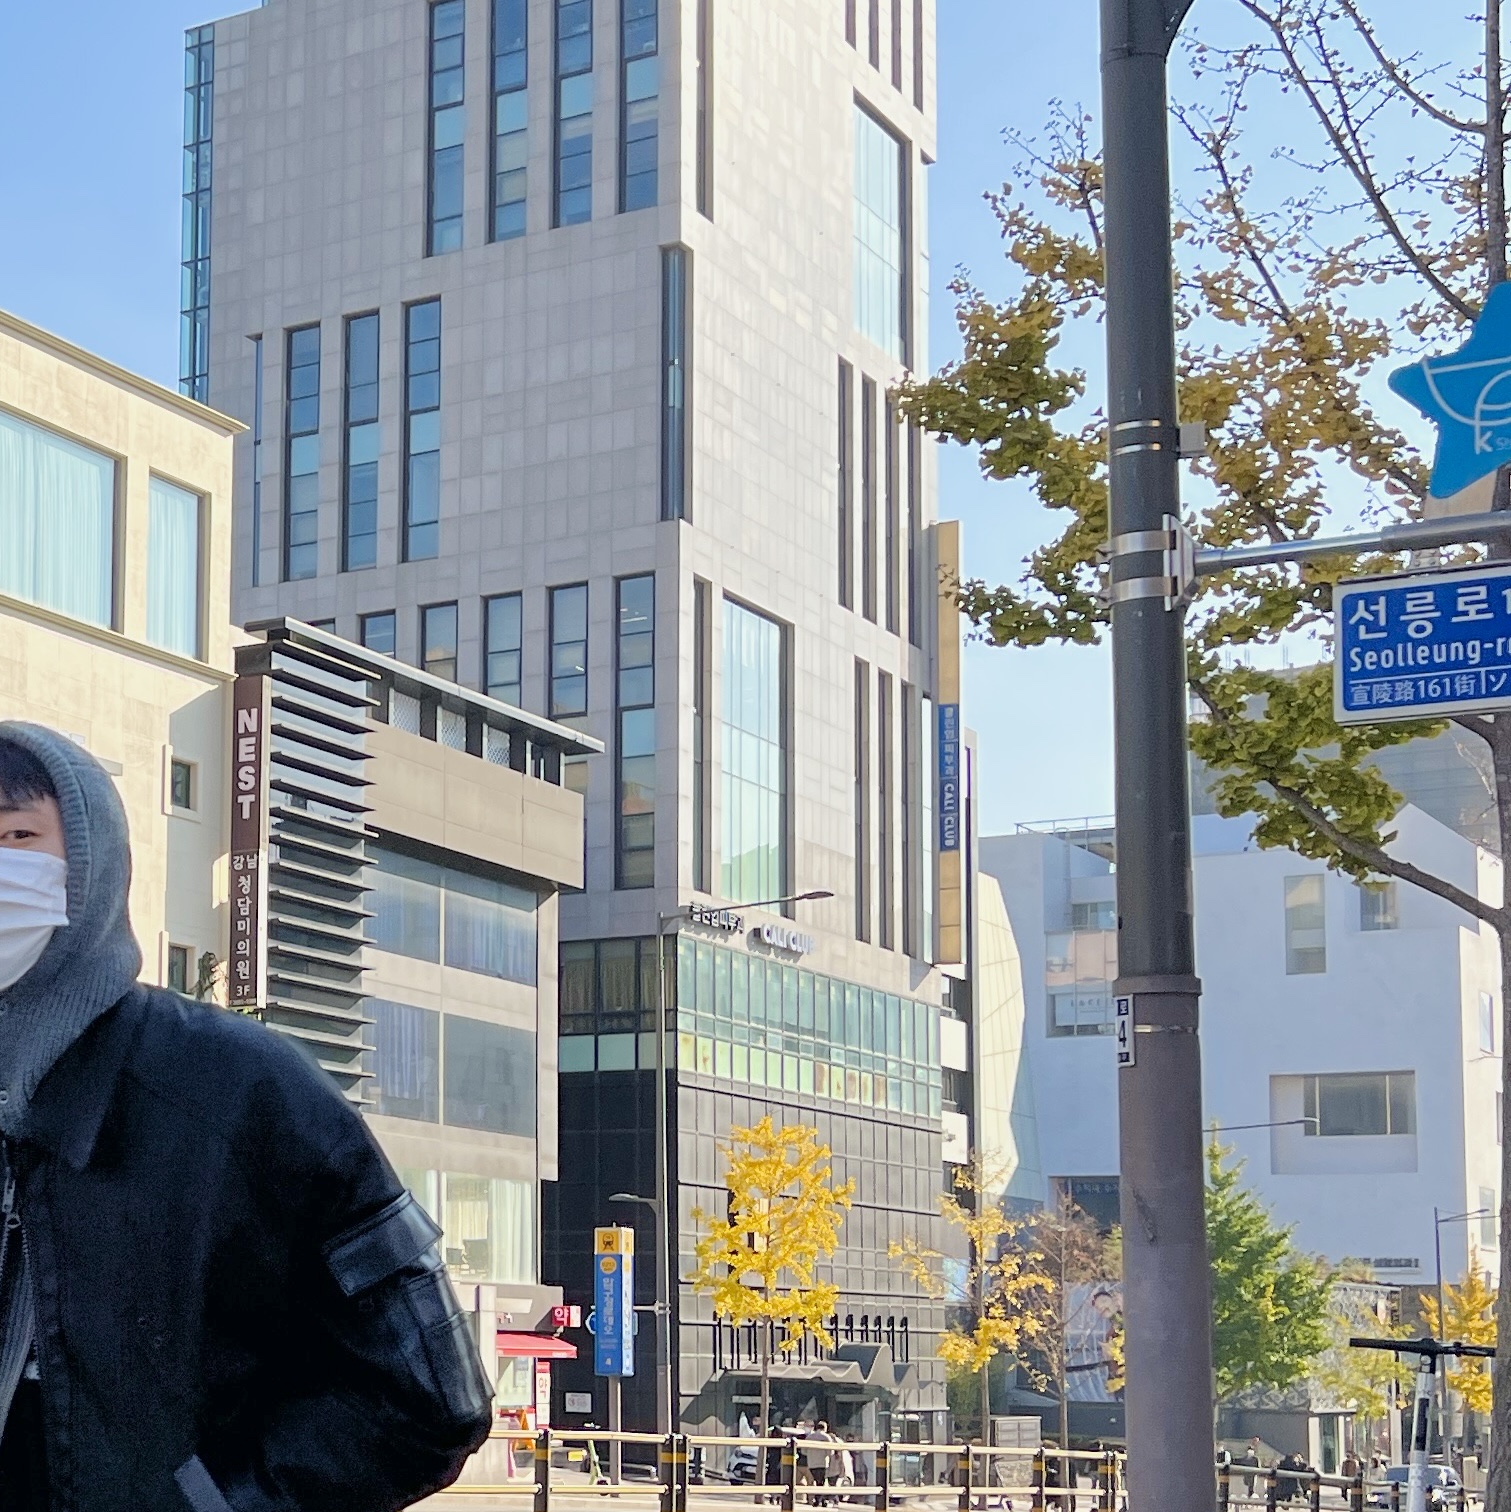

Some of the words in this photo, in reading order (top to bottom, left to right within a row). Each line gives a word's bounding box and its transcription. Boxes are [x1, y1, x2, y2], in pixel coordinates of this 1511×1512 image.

[237, 707, 258, 820] NEST
[944, 816, 955, 847] CLUB
[233, 853, 257, 871] 강남
[236, 874, 252, 980] 청담미의원
[762, 924, 787, 949] CALI
[236, 984, 251, 997] 3F
[554, 1306, 570, 1327] 약
